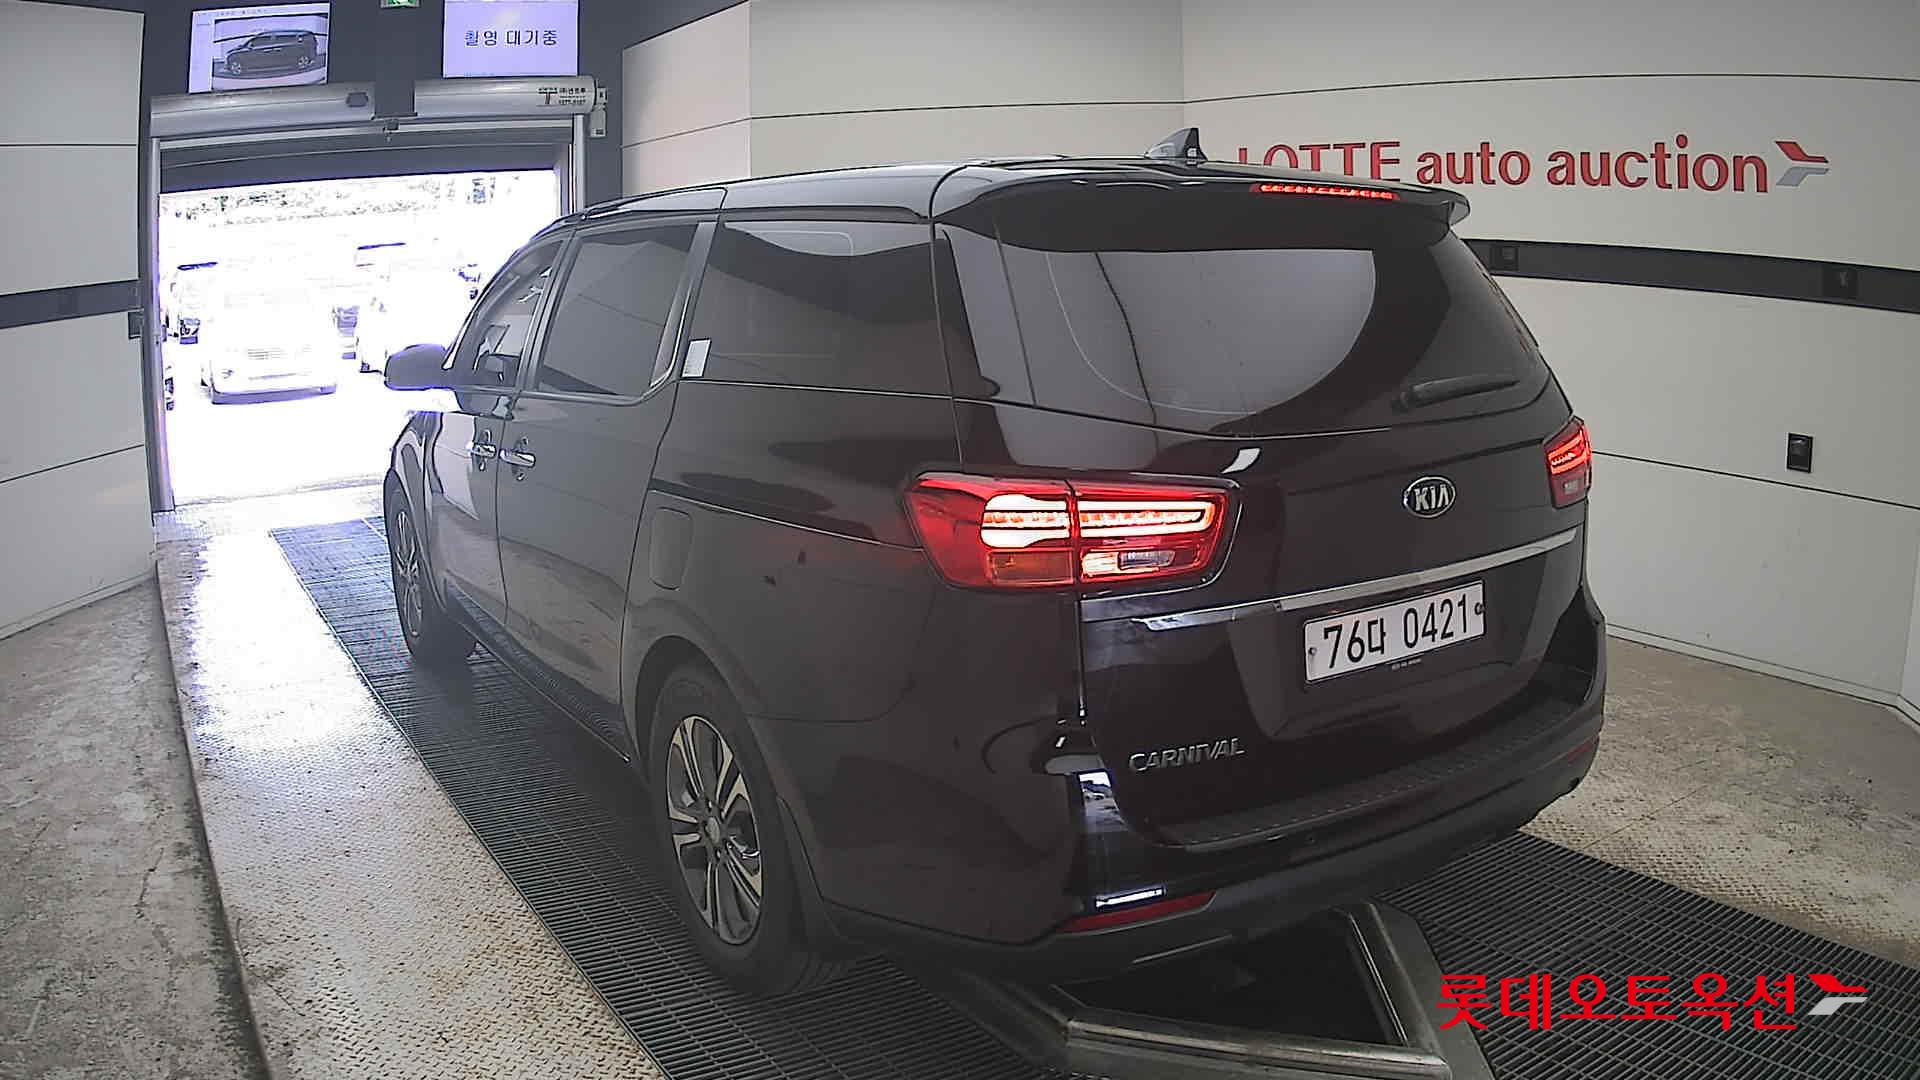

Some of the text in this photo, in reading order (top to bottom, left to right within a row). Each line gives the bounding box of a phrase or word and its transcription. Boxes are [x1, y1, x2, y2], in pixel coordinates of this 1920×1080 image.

[506, 30, 558, 46] 대기중
[1417, 141, 1530, 185] auto
[1548, 135, 1768, 193] auction
[1413, 484, 1449, 510] KIA
[1323, 593, 1468, 669] 76다 0421
[1128, 737, 1245, 772] CARNIVAL
